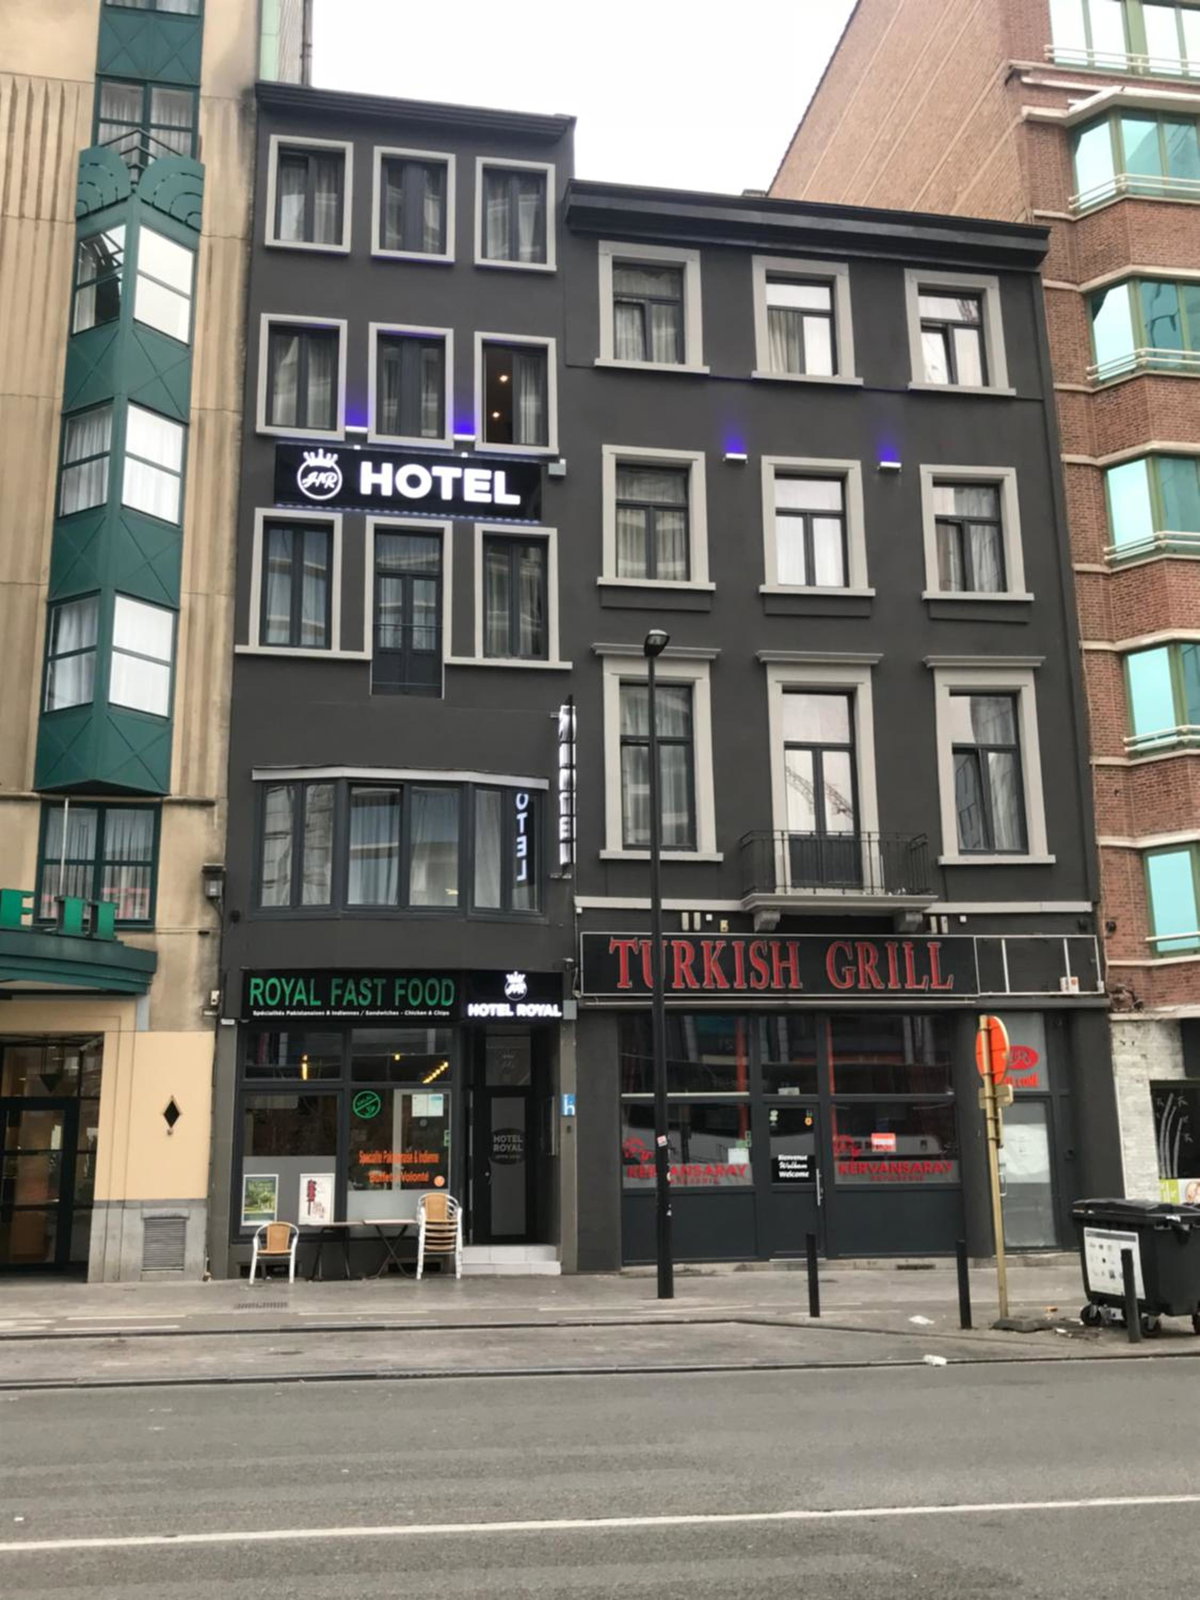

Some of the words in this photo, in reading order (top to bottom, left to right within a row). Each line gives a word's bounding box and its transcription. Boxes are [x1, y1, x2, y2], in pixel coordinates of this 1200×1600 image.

[360, 461, 521, 505] HOTEL
[609, 937, 803, 989] TURKISH
[826, 940, 954, 991] GRILL
[249, 977, 322, 1006] ROYAL
[330, 978, 387, 1006] FAST
[394, 977, 455, 1007] FOOD
[467, 1003, 515, 1017] HOTEL
[516, 1003, 562, 1018] ROYAL
[493, 1134, 523, 1143] HOTEL
[493, 1144, 524, 1152] ROYAL
[626, 1163, 748, 1178] KERANSARAY
[778, 1170, 810, 1178] Welcome
[837, 1160, 953, 1176] KERVANSARAY
